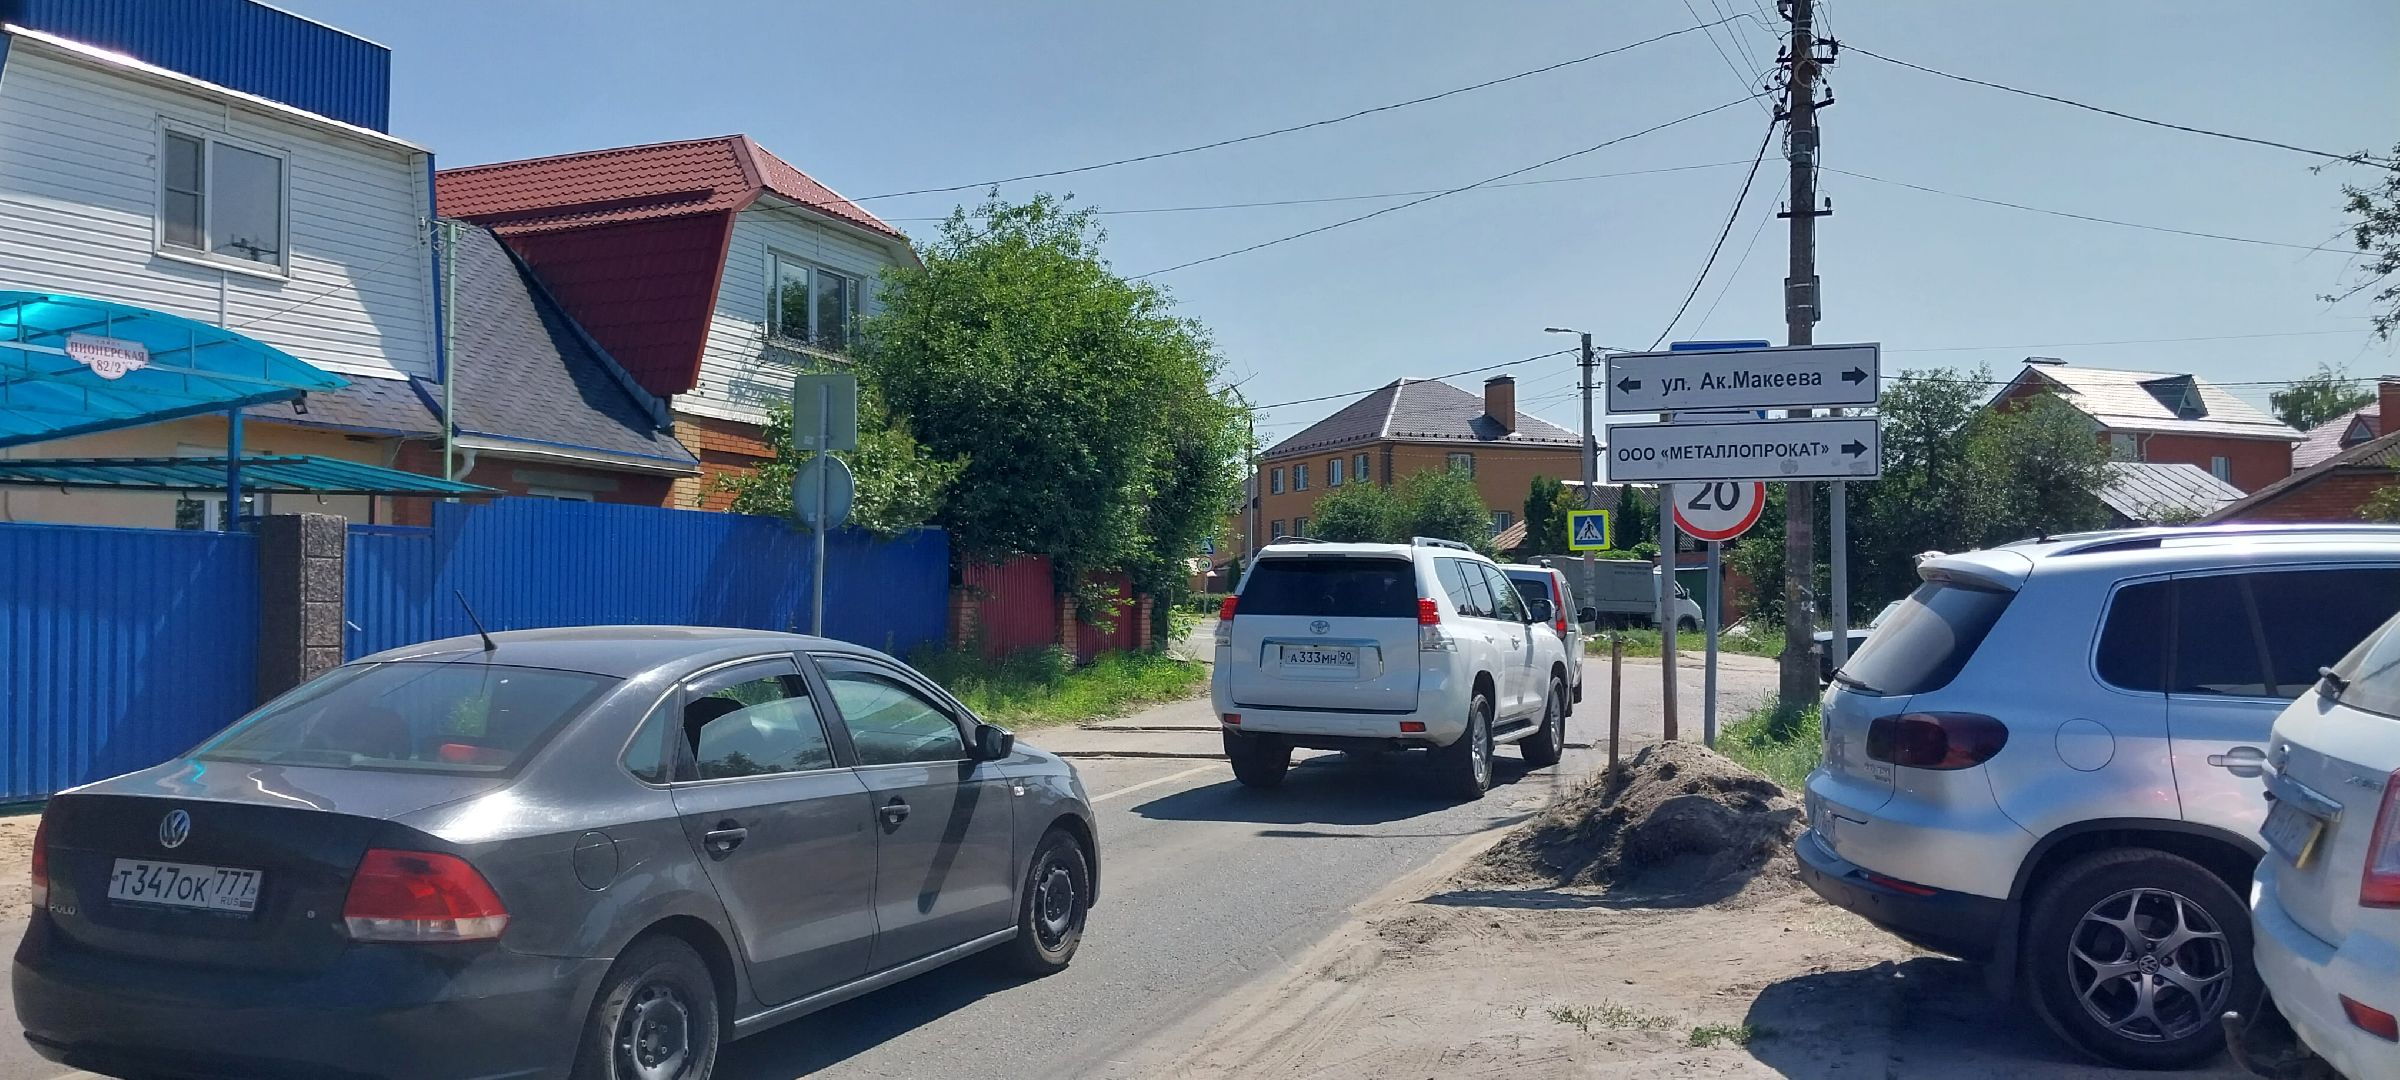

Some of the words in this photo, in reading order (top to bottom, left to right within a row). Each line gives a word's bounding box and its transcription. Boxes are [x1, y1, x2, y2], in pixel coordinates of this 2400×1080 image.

[70, 341, 145, 362] ПИОНЕРСКАЯ
[96, 359, 121, 373] 82/2
[1661, 376, 1691, 396] ул.
[1700, 370, 1822, 391] Ак.Макеева
[1618, 447, 1656, 462] ООО
[1661, 441, 1830, 461] «МЕТАЛЛОПРОКАТ»
[1687, 482, 1741, 512] 20
[120, 865, 210, 902] Т347ОК
[214, 870, 254, 896] 777
[48, 903, 77, 916] POLO
[220, 896, 240, 906] RUS
